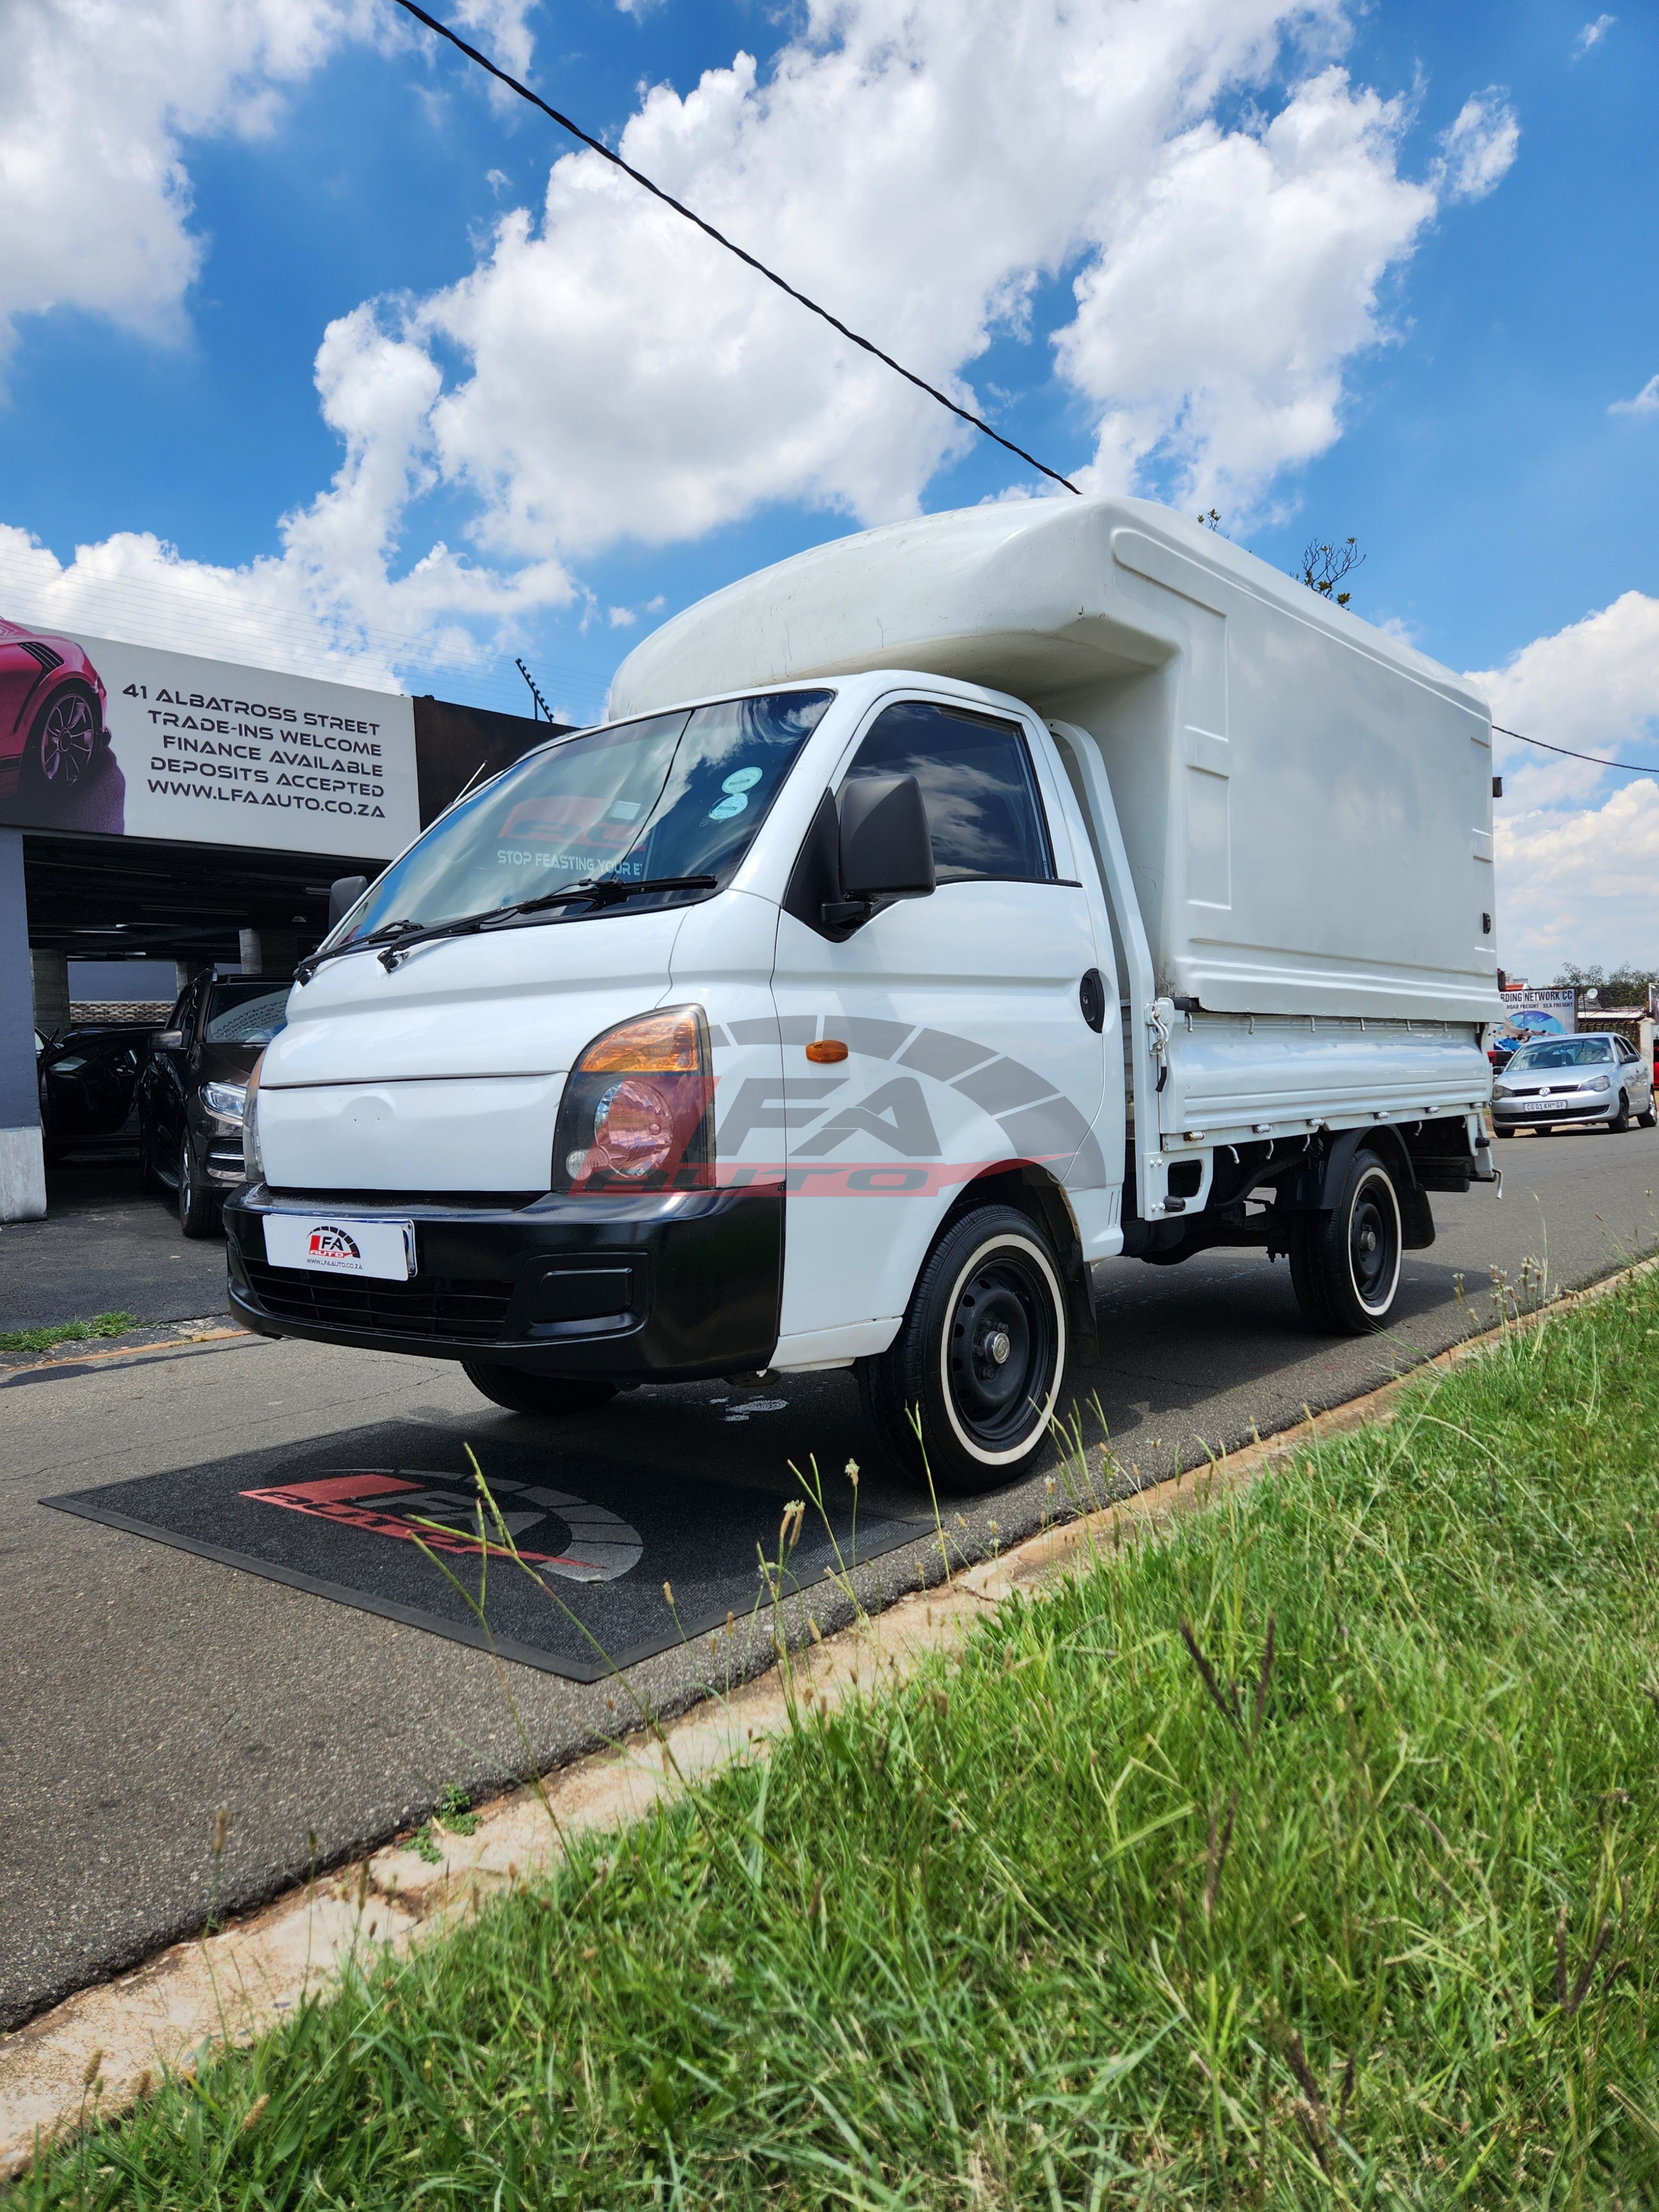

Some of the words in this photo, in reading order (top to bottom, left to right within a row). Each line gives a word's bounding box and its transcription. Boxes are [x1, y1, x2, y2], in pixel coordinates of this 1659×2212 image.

[123, 684, 147, 699] 41
[156, 689, 297, 723] ALBATROSS
[304, 712, 381, 735] STREET
[148, 710, 273, 740] TRADE-INS
[280, 730, 382, 756] WELCOME
[163, 735, 262, 761] FINANCE
[269, 750, 383, 777] AVAILABLE
[151, 757, 269, 783] DEPOSITS
[276, 773, 384, 797] ACCEPTED
[148, 779, 385, 818] WWW.LFAAUTO.CO.ZA
[497, 850, 531, 865] STOP
[535, 853, 594, 872] FEASTING
[597, 859, 630, 876] YOUR
[1500, 993, 1522, 1002] RDING
[1524, 991, 1560, 1001] NETWORK
[1563, 990, 1572, 1000] CC
[307, 1258, 363, 1269] WWW.LFAAUTO.CO.ZA
